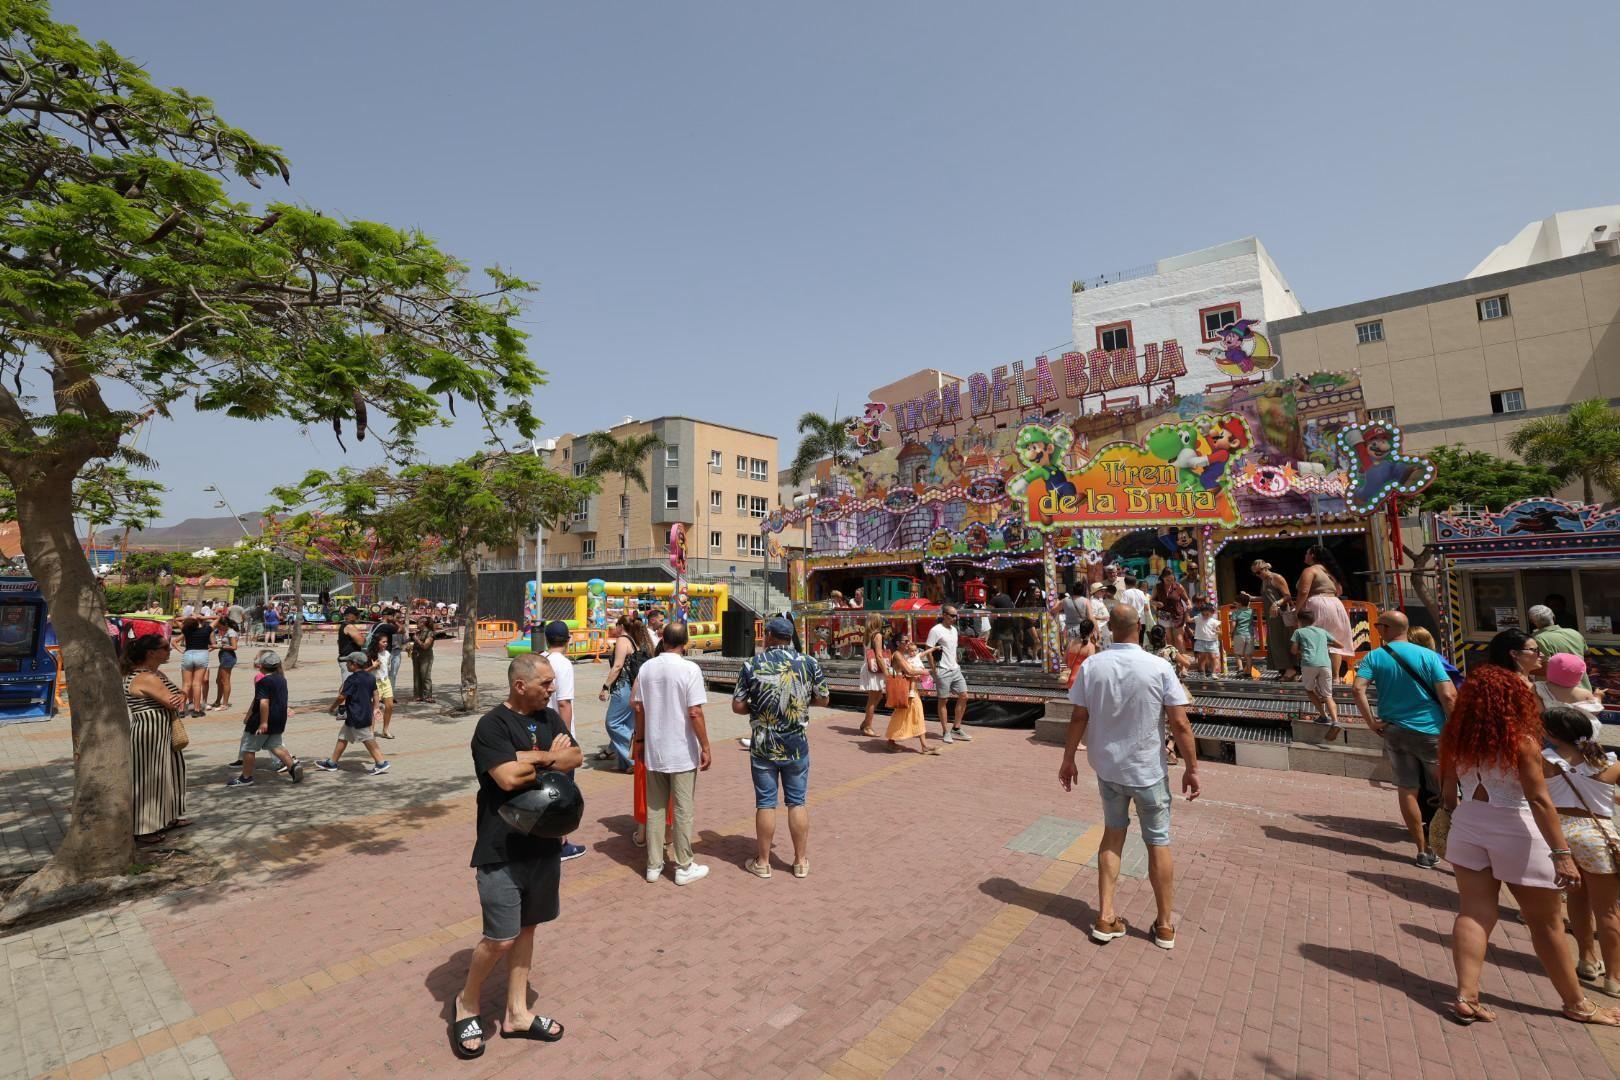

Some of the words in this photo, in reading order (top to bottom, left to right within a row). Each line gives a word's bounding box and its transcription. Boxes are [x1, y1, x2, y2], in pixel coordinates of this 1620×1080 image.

[890, 382, 963, 432] TREN
[967, 365, 1011, 416] DE
[1013, 355, 1060, 408] LA
[1062, 339, 1188, 398] BRUJA
[1100, 460, 1179, 487] Tren
[1038, 488, 1079, 515] de
[1086, 488, 1117, 514] la
[1123, 487, 1216, 518] Bruja
[460, 1029, 483, 1039] adidas
